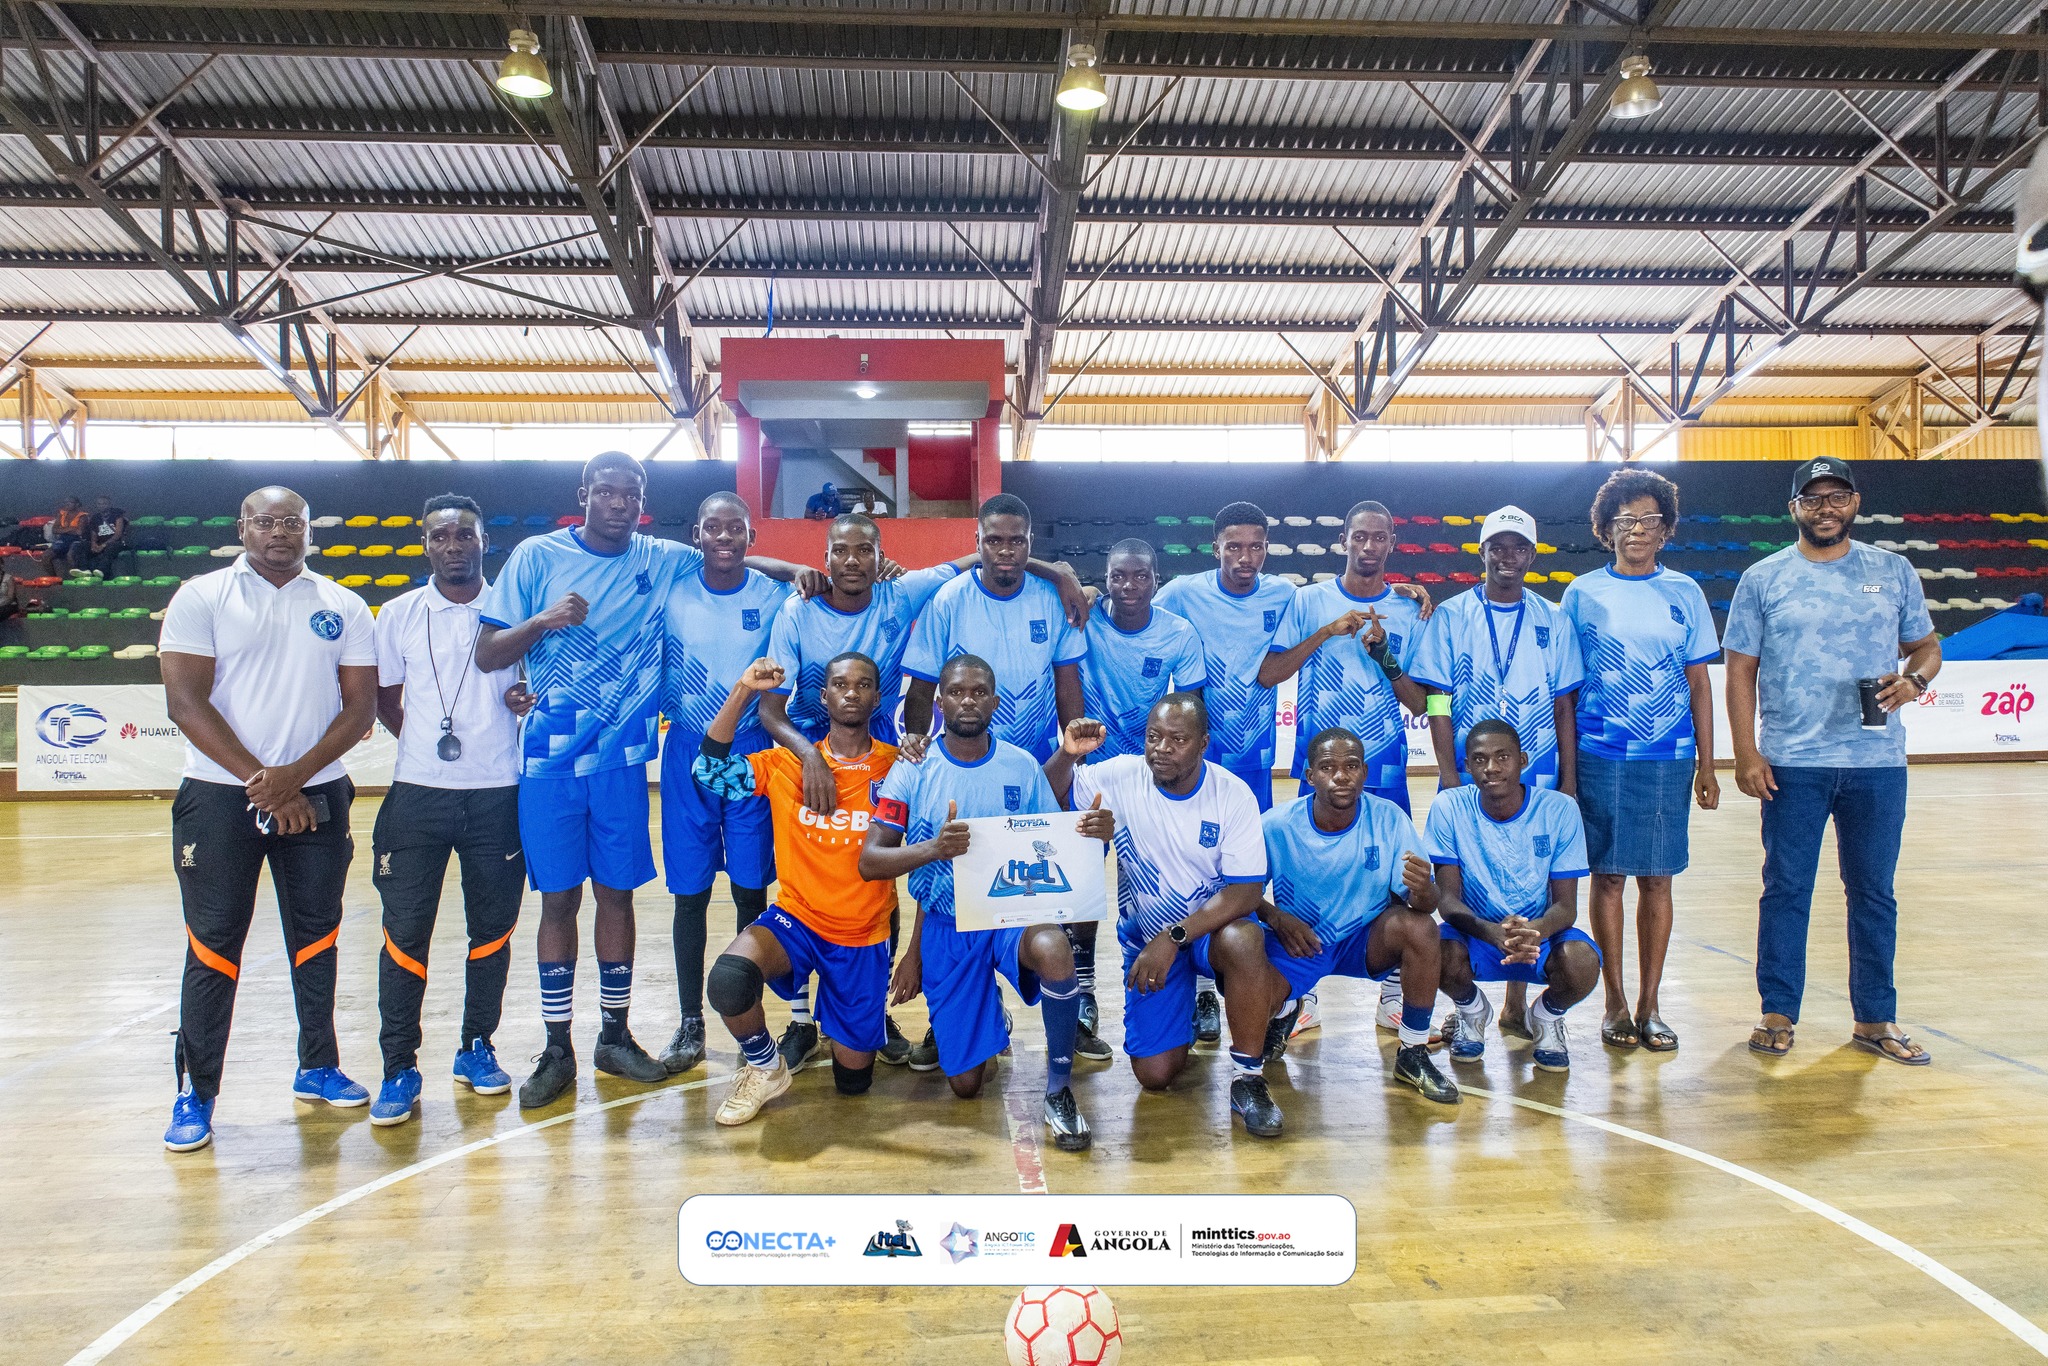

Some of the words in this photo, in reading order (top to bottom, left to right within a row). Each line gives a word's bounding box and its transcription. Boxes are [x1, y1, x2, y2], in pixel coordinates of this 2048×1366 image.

[140, 727, 181, 737] HUAWEI
[36, 754, 68, 765] ANGOLA
[70, 753, 107, 764] TELECOM
